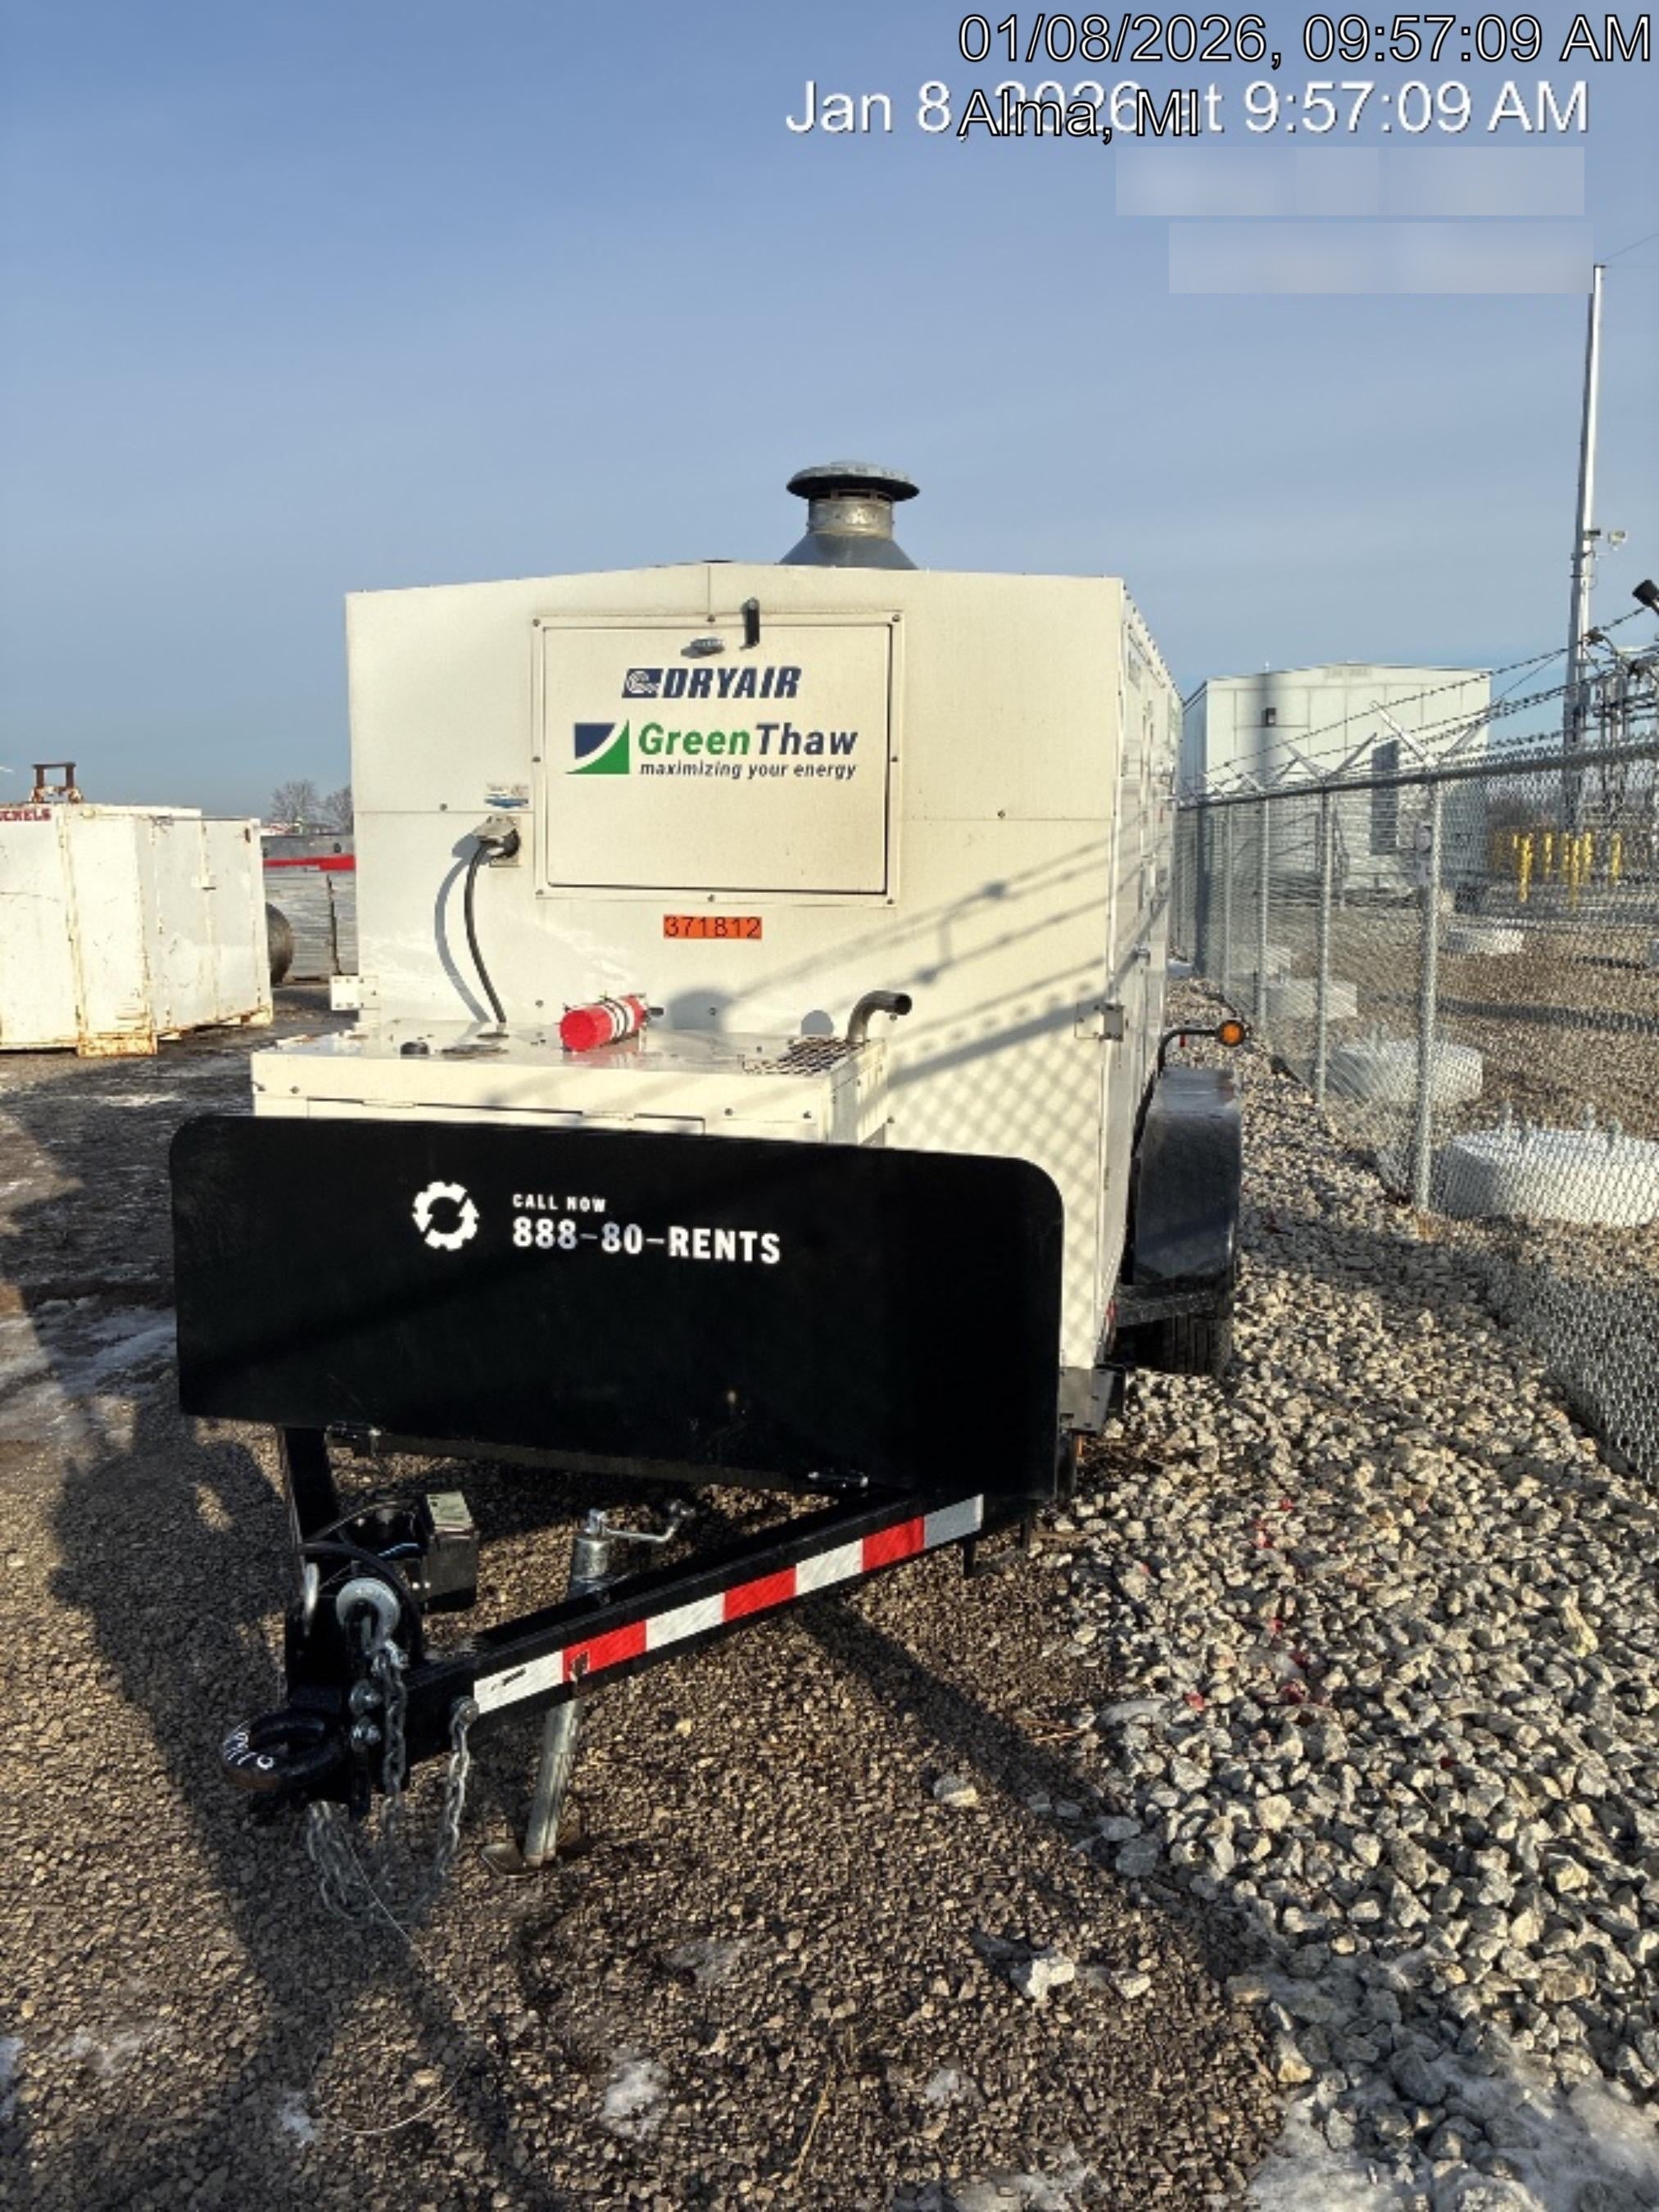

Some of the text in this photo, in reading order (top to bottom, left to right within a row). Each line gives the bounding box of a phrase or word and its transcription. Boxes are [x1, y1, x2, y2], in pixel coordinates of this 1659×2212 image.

[661, 666, 802, 699] DRYAIR
[639, 760, 857, 781] maximizing your energy
[664, 915, 762, 939] 371812
[512, 1194, 606, 1213] CALL NOW
[513, 1216, 780, 1264] 888-80-RENTS
